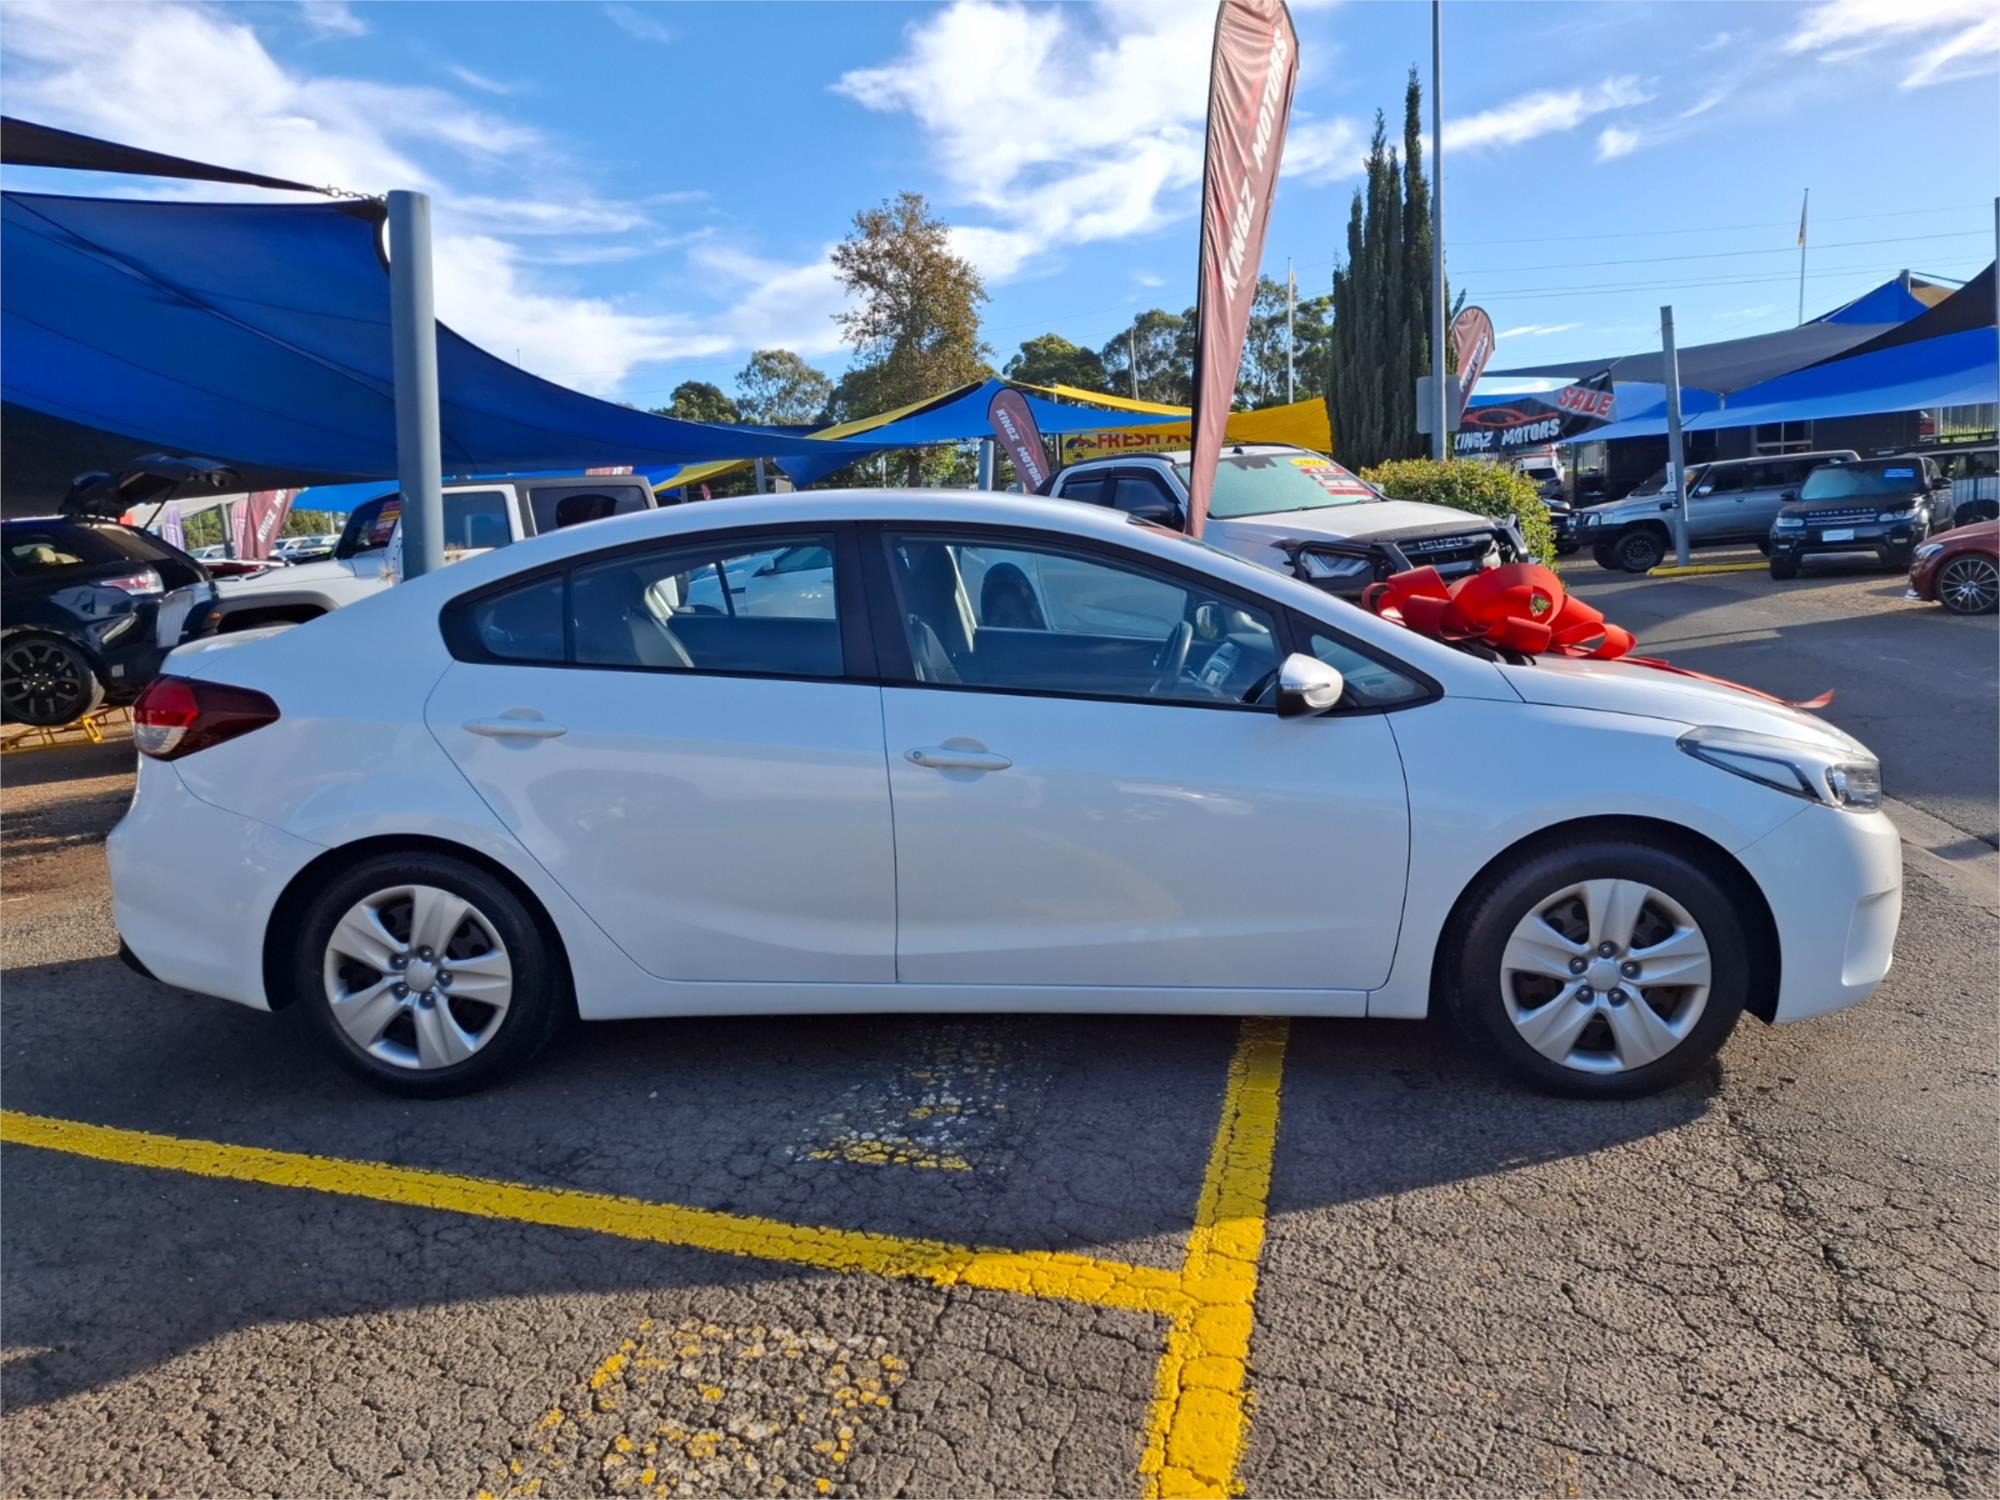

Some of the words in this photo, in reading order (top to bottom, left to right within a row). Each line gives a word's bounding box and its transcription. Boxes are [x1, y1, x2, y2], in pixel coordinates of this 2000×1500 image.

[1223, 176, 1256, 301] KINGZ
[1252, 27, 1288, 173] MOTORS
[1558, 386, 1614, 416] SALE
[996, 409, 1020, 442] KINGZ
[1501, 418, 1561, 446] MOTORS
[257, 508, 277, 543] KINGZ
[1418, 537, 1464, 551] ISUZU
